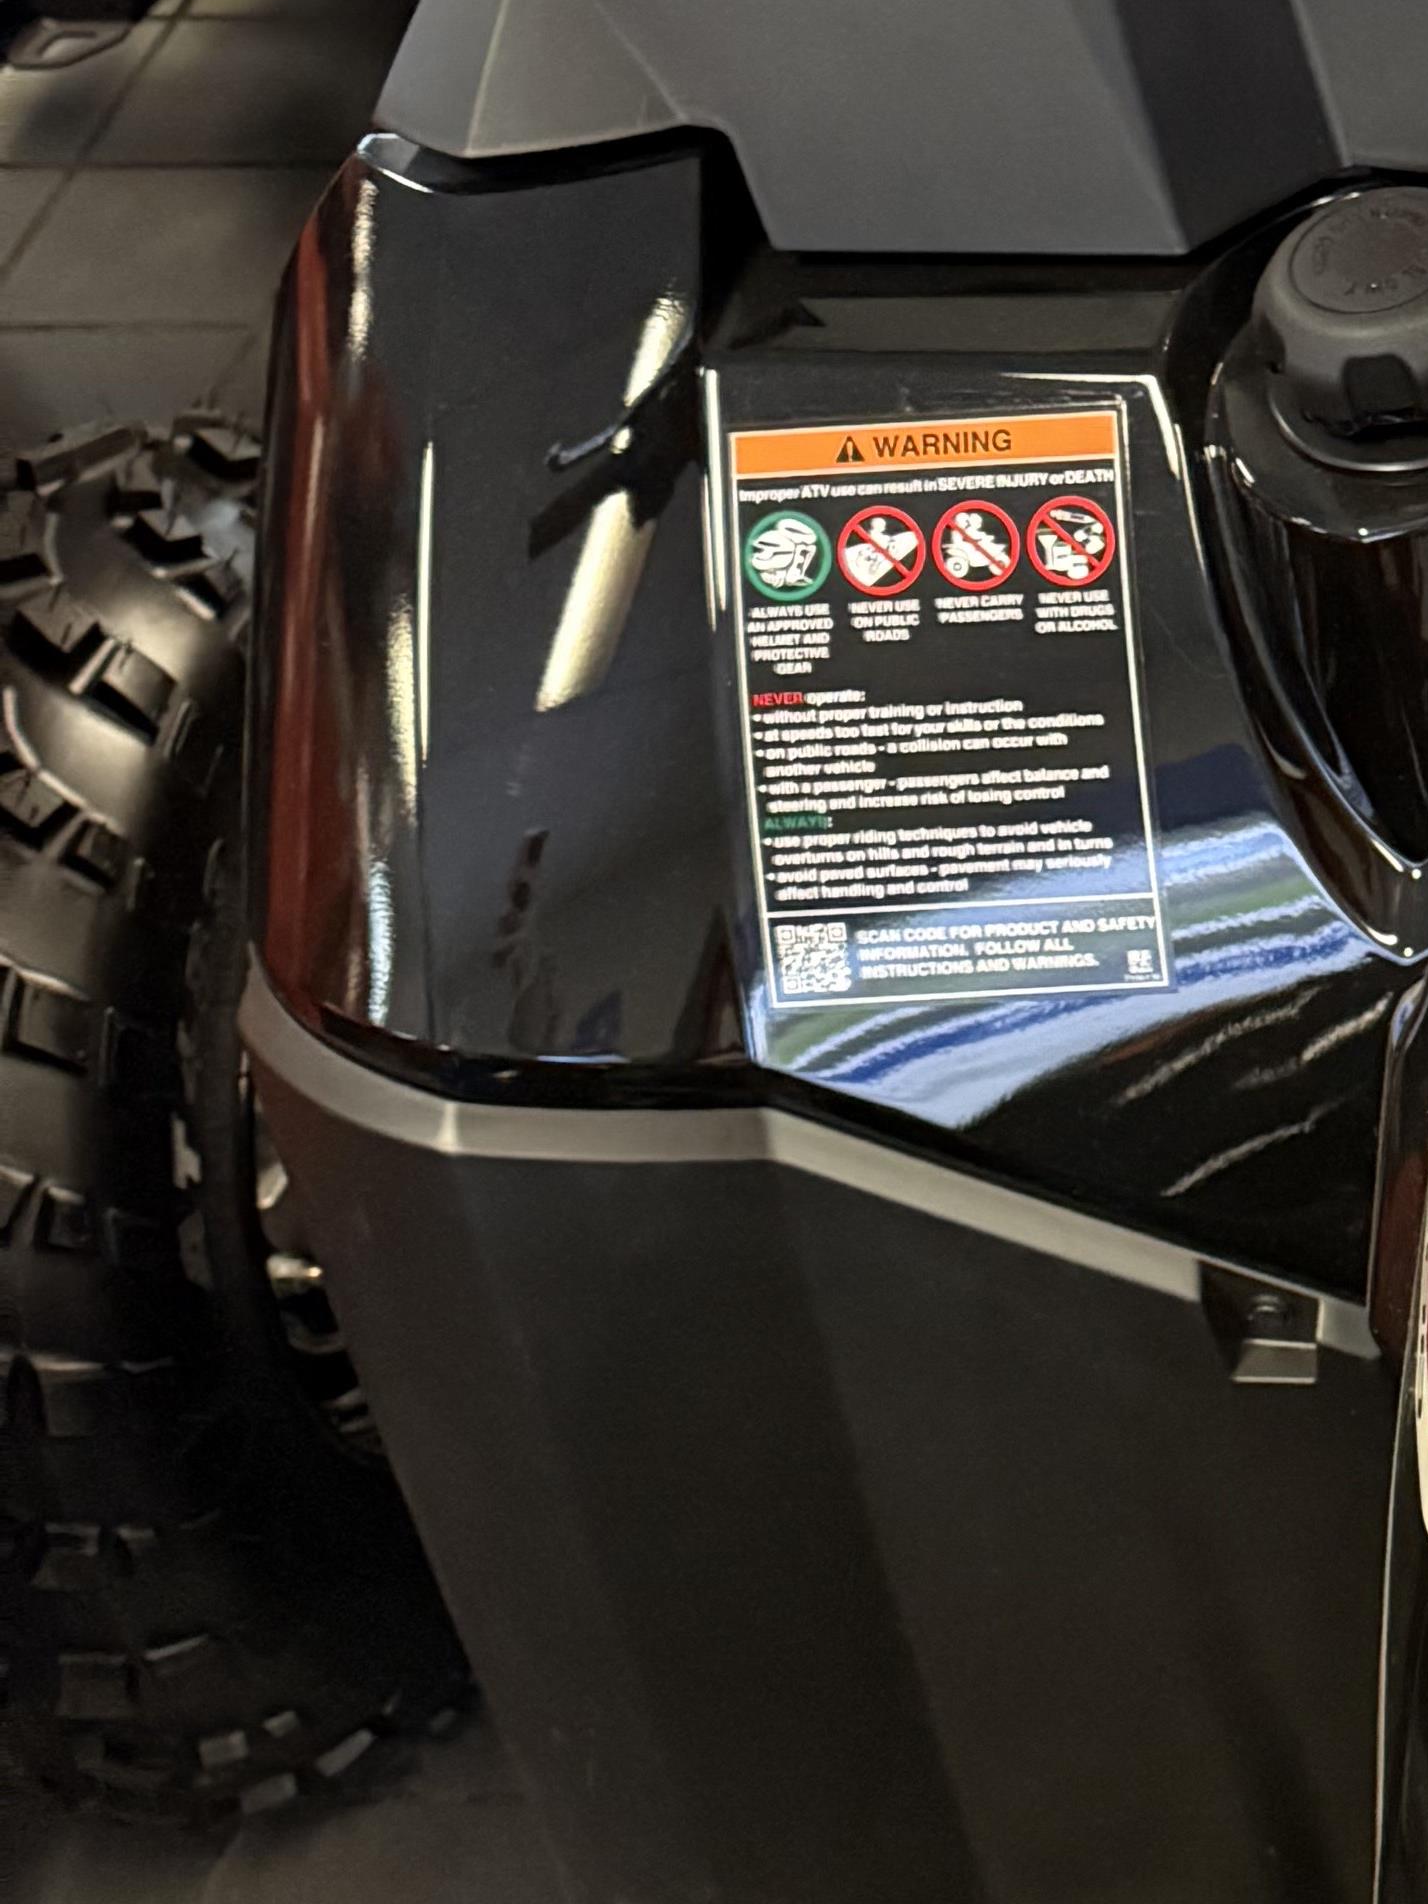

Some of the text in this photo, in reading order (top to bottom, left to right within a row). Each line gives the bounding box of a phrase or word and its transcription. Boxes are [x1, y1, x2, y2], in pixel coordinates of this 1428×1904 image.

[873, 429, 1012, 458] WARNING
[800, 484, 830, 498] ATV
[938, 474, 995, 491] SEVERE
[996, 471, 1049, 488] INJURY
[1065, 469, 1115, 483] DEATH
[855, 915, 1157, 945] SCAN CODE FOR PRODUCT AND SAFETY
[857, 937, 1074, 962] INFORMATION. FOLLOW ALL
[860, 953, 1100, 980] INSTRUCTIONS AND WARNINGS.
